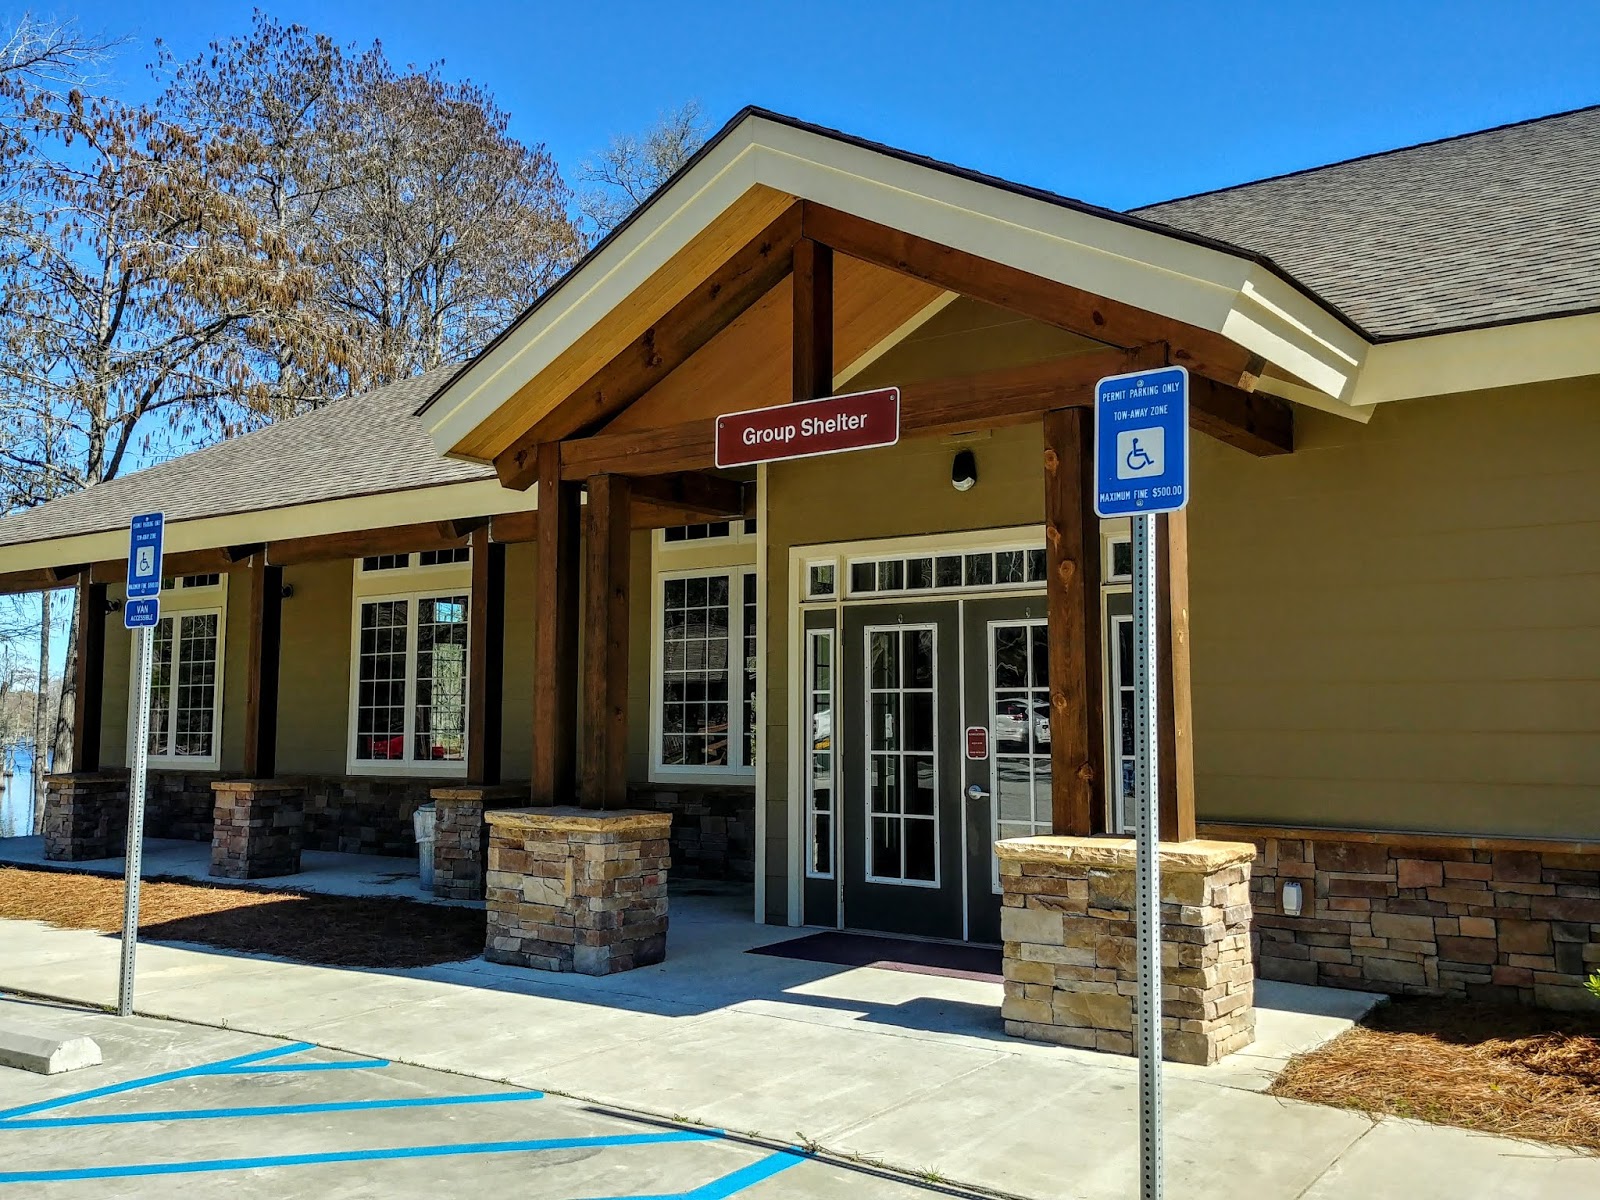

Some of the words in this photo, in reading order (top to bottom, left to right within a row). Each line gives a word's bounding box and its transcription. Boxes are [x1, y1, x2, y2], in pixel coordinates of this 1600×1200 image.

[1102, 390, 1126, 402] PERMIT
[1129, 385, 1159, 398] PARKING
[1162, 382, 1180, 393] ONLY
[1114, 407, 1148, 421] TOW-AWAY
[1150, 404, 1168, 416] ZONE
[742, 424, 796, 446] Group
[801, 413, 868, 437] Shelter
[1100, 491, 1131, 503] MAXIMUM
[1133, 488, 1149, 499] FINE
[1152, 485, 1182, 498] $500.00
[136, 604, 149, 614] VAN
[130, 614, 154, 622] ACCESSIBLE
